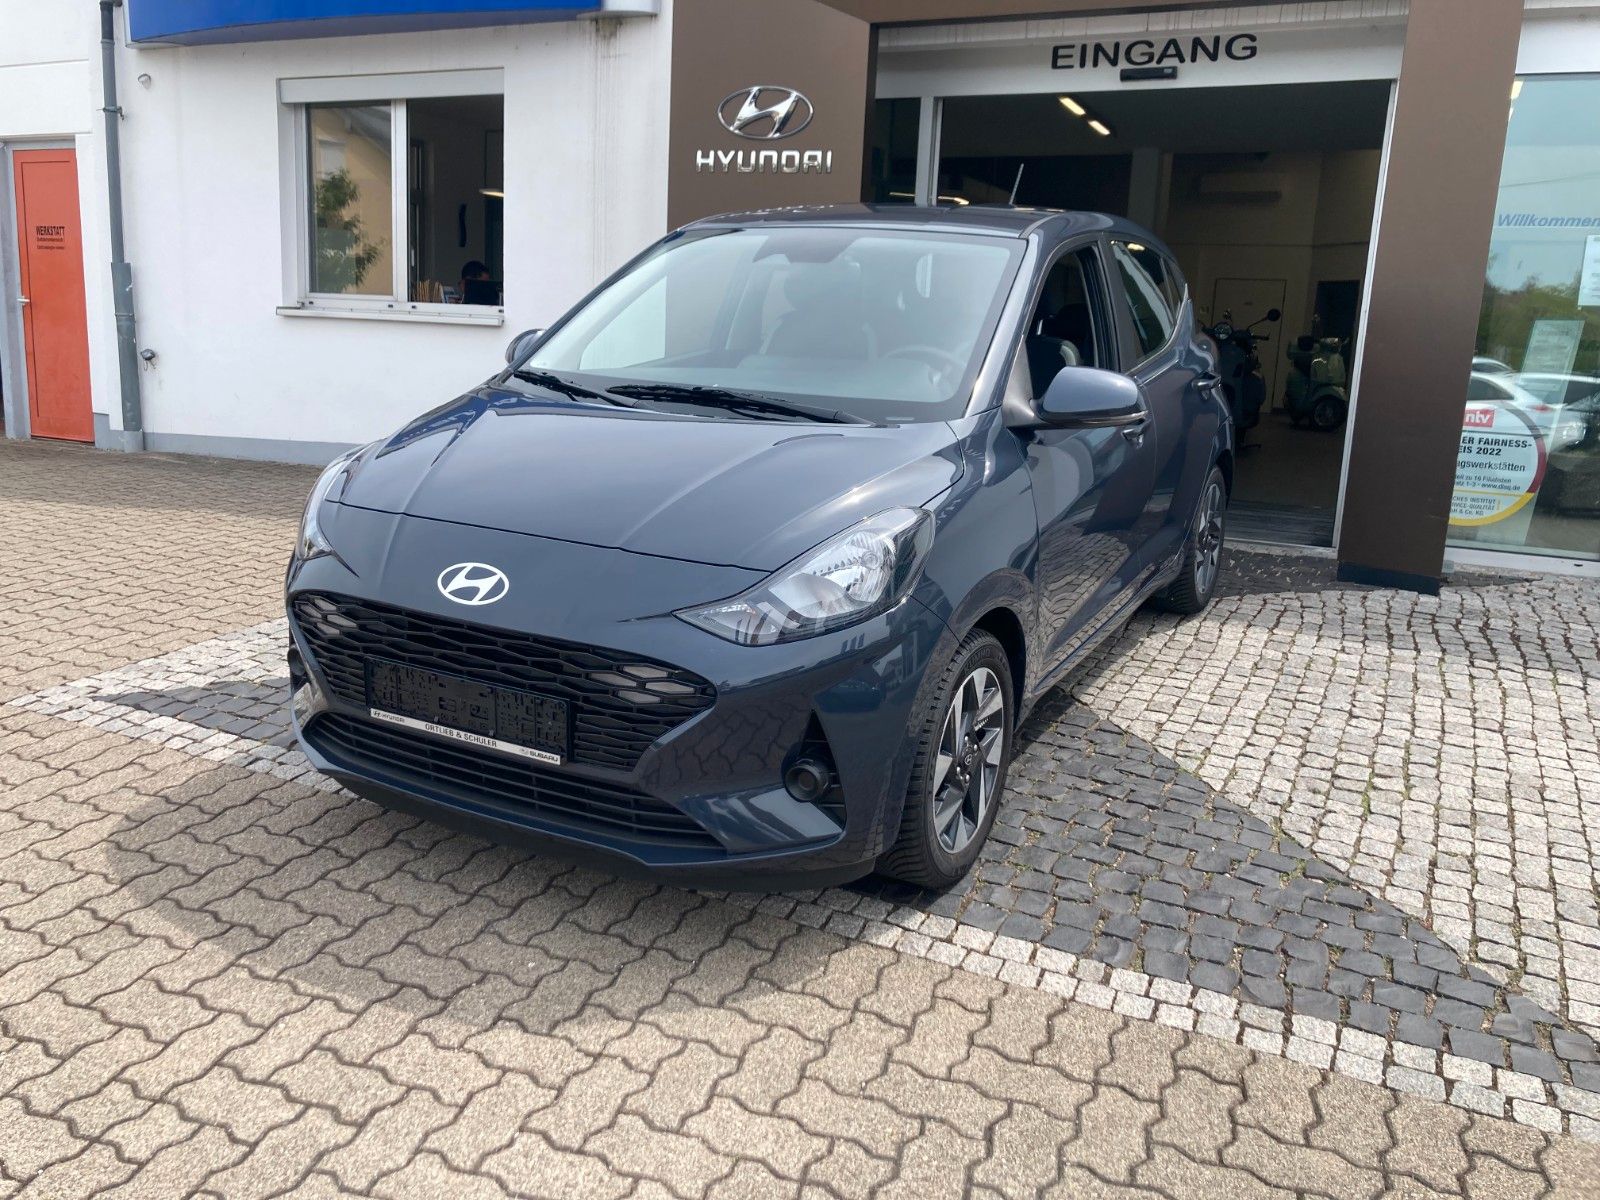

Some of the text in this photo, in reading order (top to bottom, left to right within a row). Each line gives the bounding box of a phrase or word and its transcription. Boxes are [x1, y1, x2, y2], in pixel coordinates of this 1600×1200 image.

[1051, 33, 1258, 70] EINGANG
[695, 149, 833, 174] HYUNDAI
[1497, 213, 1600, 228] Willkommen
[36, 225, 65, 236] WERKSTATT
[1478, 437, 1532, 449] FAIRNESS-
[1476, 447, 1502, 457] 2022
[425, 723, 454, 739] ORTLIEB
[456, 731, 463, 739] &
[529, 750, 559, 763] SUBARU
